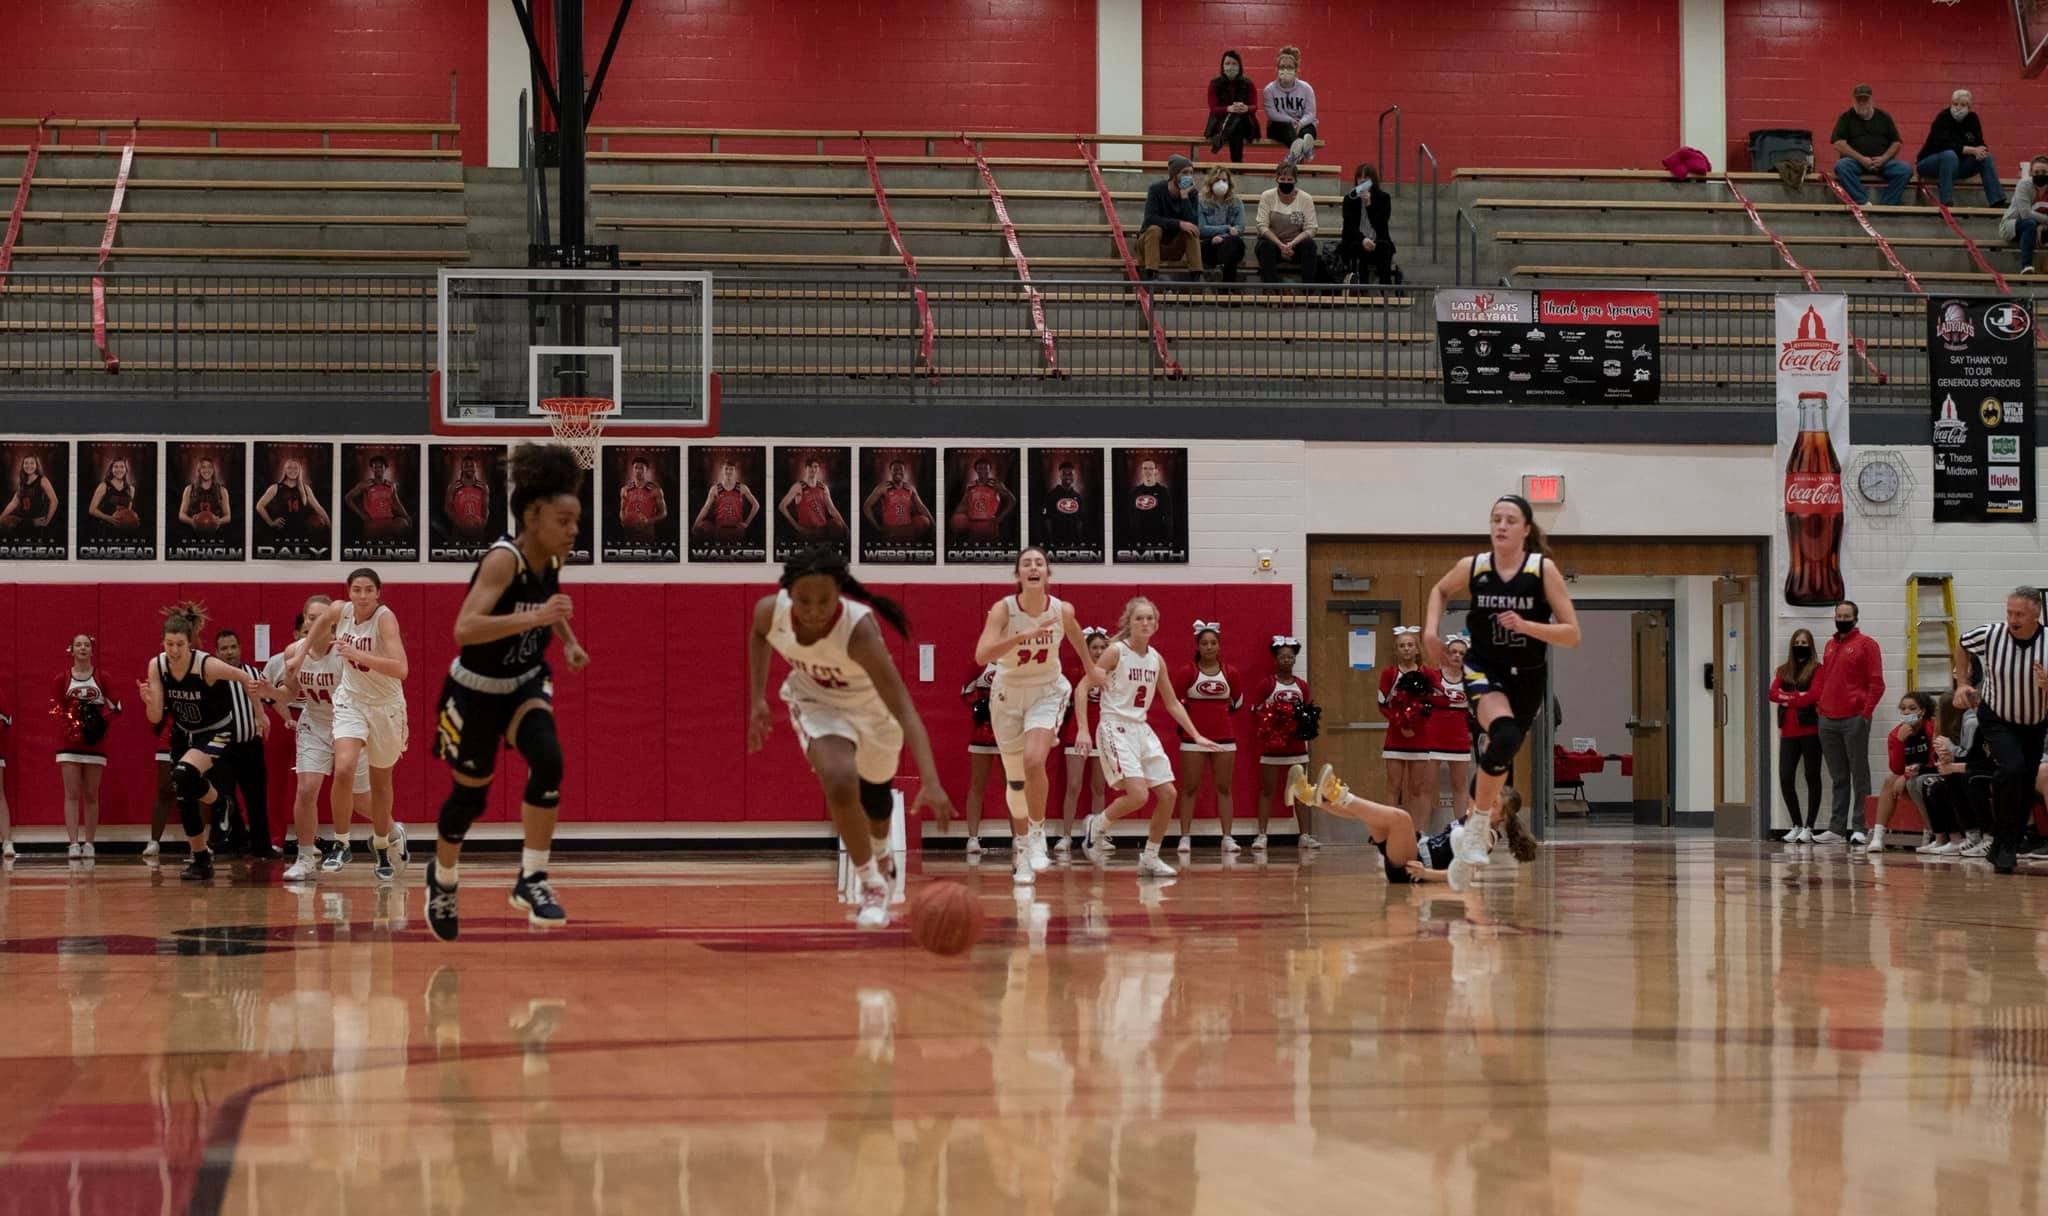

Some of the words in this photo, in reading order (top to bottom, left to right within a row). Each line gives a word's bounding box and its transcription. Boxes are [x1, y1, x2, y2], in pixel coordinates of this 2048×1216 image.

[1274, 96, 1305, 112] PINK
[1451, 301, 1477, 311] LADY
[1492, 303, 1519, 312] JAYS
[1543, 299, 1578, 316] Thank
[1581, 305, 1603, 321] you
[1606, 302, 1653, 321] Sponsors
[1451, 312, 1519, 321] VOLLEYBALL
[1779, 349, 1842, 371] Coca-Cola
[1950, 355, 1964, 365] SAY
[1966, 355, 1990, 365] THANK
[1991, 355, 2008, 365] YOU
[1964, 367, 1975, 376] TO
[1976, 367, 1993, 376] OUR
[1938, 378, 1979, 387] GENEROUS
[1980, 378, 2021, 388] SPONSORS
[2003, 407, 2023, 416] WILD
[1949, 453, 1973, 463] Theos
[1946, 466, 1978, 476] Midtown
[1530, 478, 1558, 498] EXIT
[0, 546, 65, 558] RAIGHEAD
[80, 546, 154, 558] CRAIGHEAD
[168, 547, 243, 559] LINTHACUM
[257, 546, 328, 558] DALY
[343, 548, 417, 560] STALLINGS
[431, 548, 489, 560] DRIVE
[604, 549, 678, 559] DESHA
[692, 548, 766, 559] WALKER
[864, 549, 935, 560] WEBSTER
[1046, 549, 1102, 560] ARDEN
[1117, 549, 1185, 560] SMITH
[1477, 595, 1534, 610] HICKMAN
[300, 671, 314, 685] JEFF
[316, 673, 334, 686] CITY
[1128, 667, 1143, 681] JEFF
[168, 689, 201, 701] ICKMAN
[1133, 685, 1147, 708] 2
